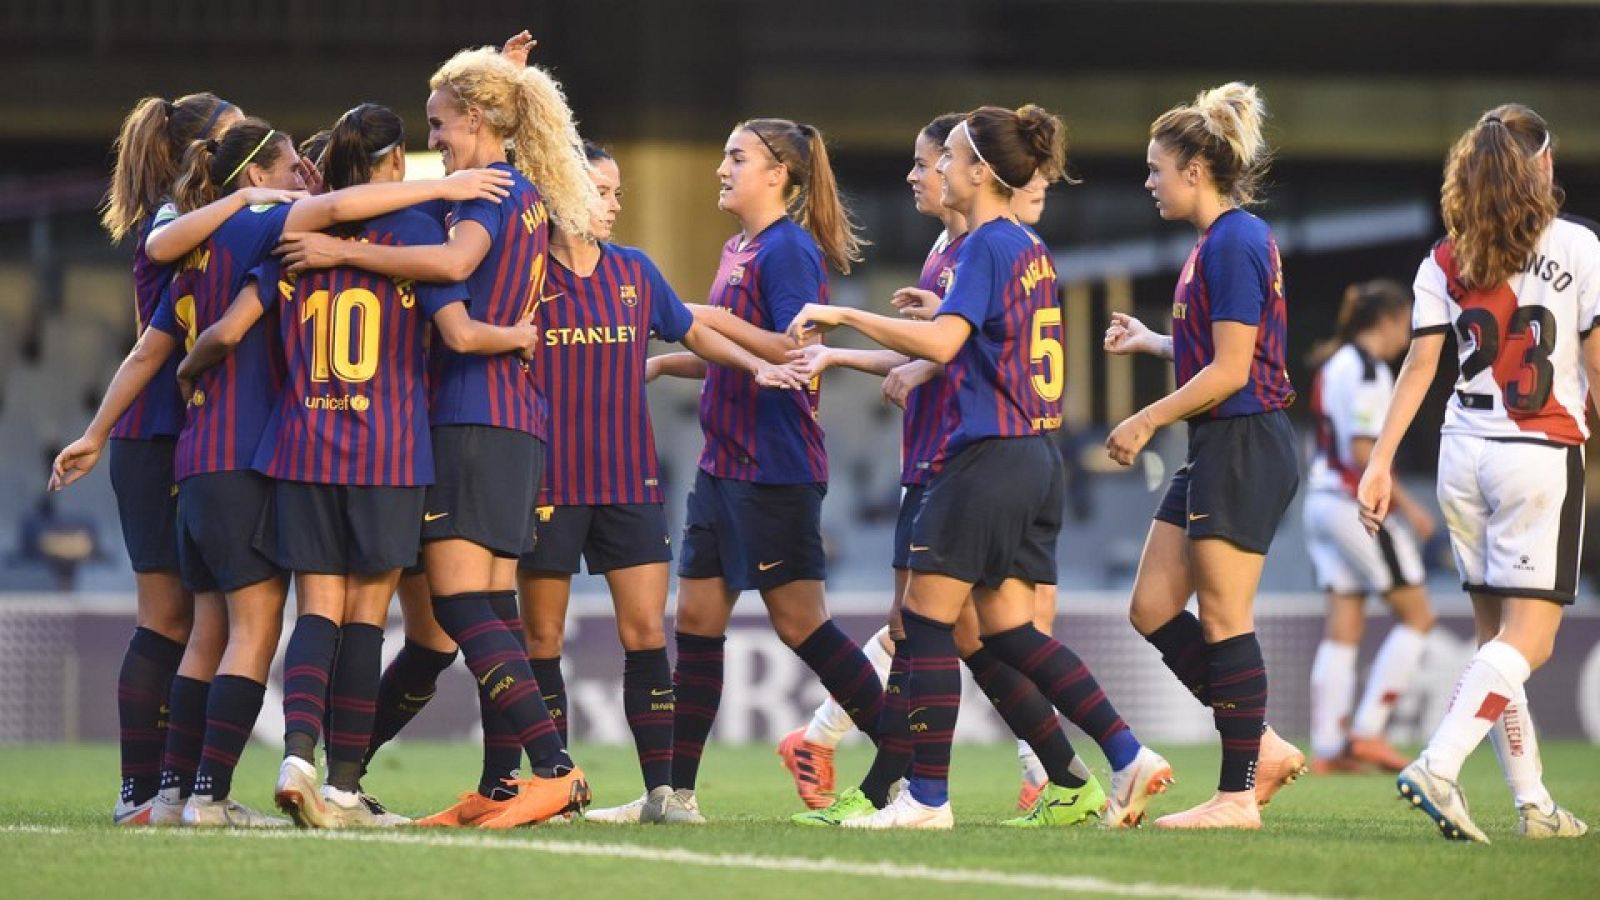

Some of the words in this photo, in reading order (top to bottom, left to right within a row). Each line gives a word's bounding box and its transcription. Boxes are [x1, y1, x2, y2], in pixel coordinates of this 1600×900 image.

[301, 287, 381, 383] 10
[544, 325, 637, 346] STANLEY
[1031, 307, 1064, 402] 5
[1456, 305, 1557, 413] 23
